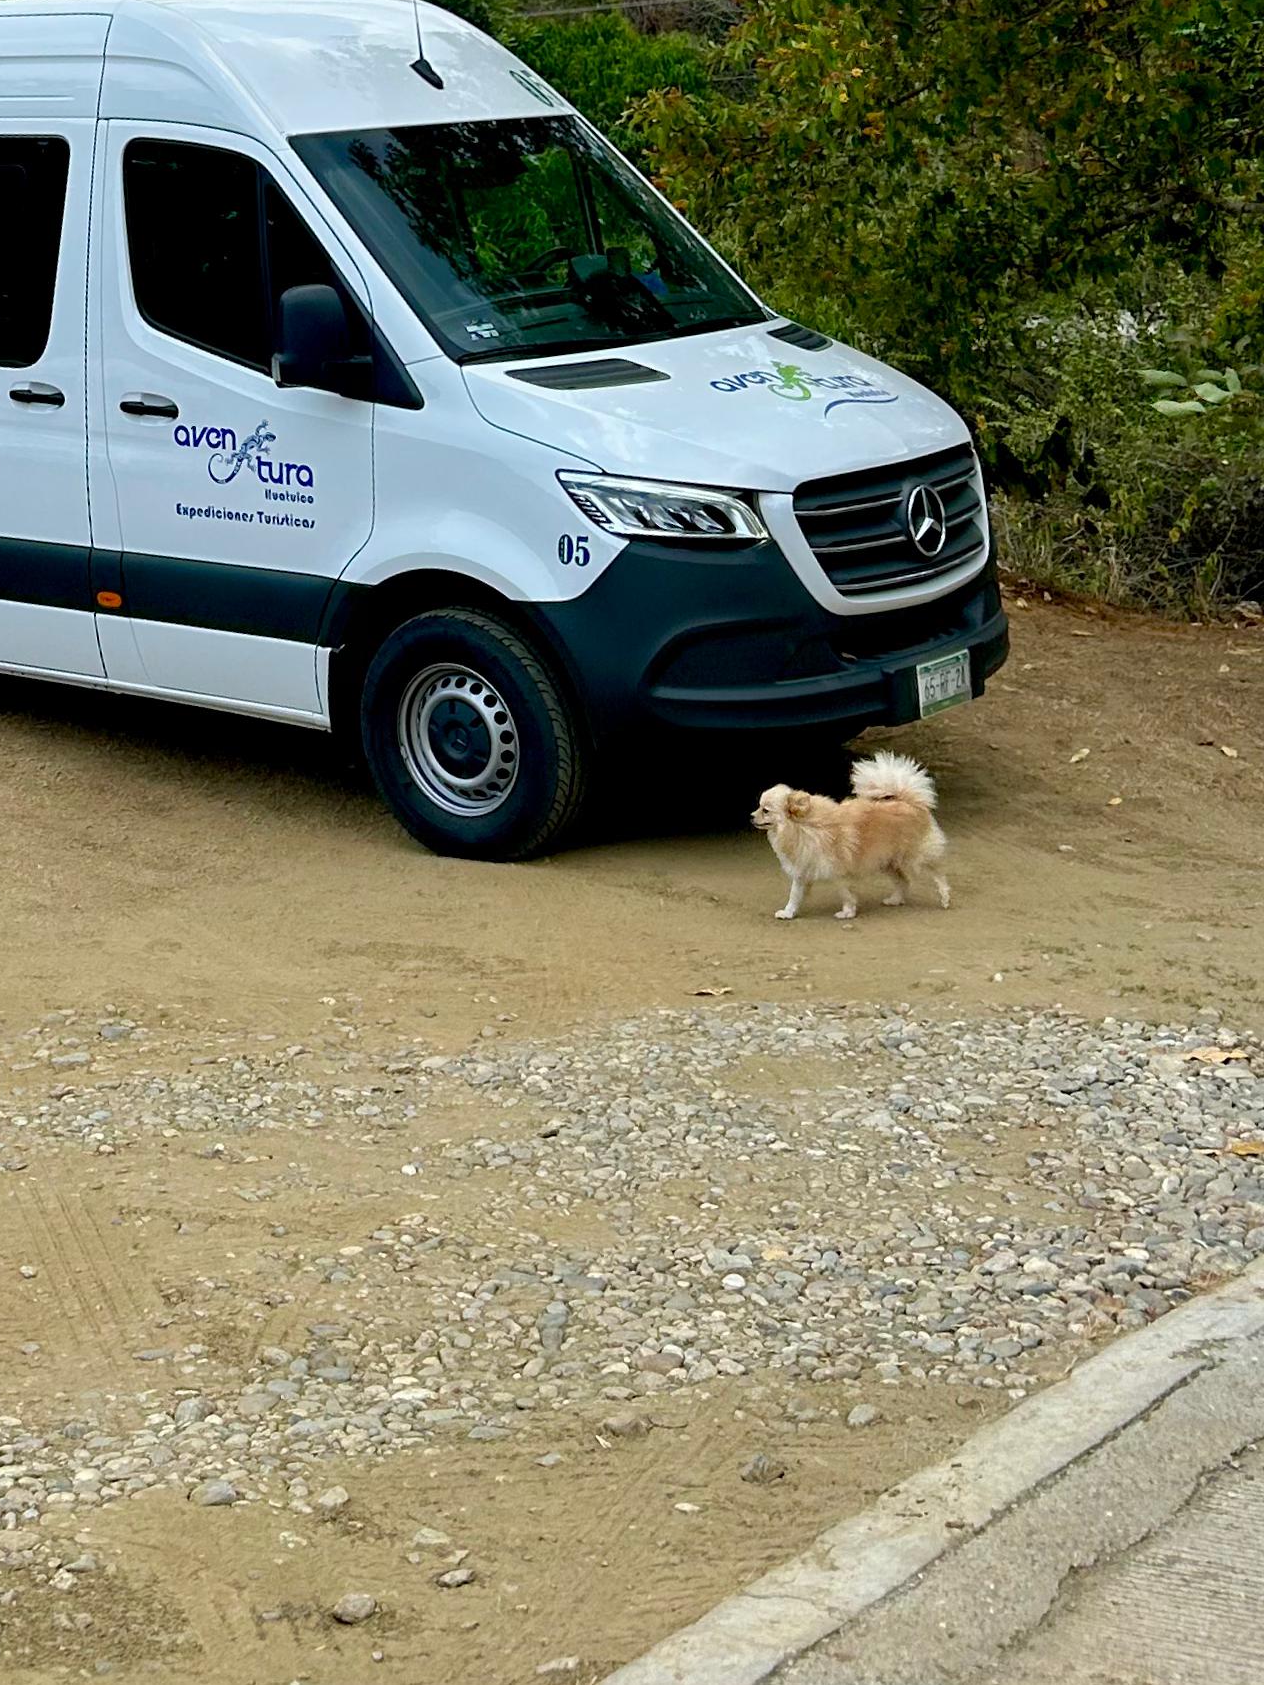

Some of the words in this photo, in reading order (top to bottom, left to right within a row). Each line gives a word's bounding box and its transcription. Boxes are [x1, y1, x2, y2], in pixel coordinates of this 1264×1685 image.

[174, 425, 236, 450] aven
[256, 456, 313, 487] tura
[176, 503, 254, 523] Expediciones
[558, 534, 590, 567] 05
